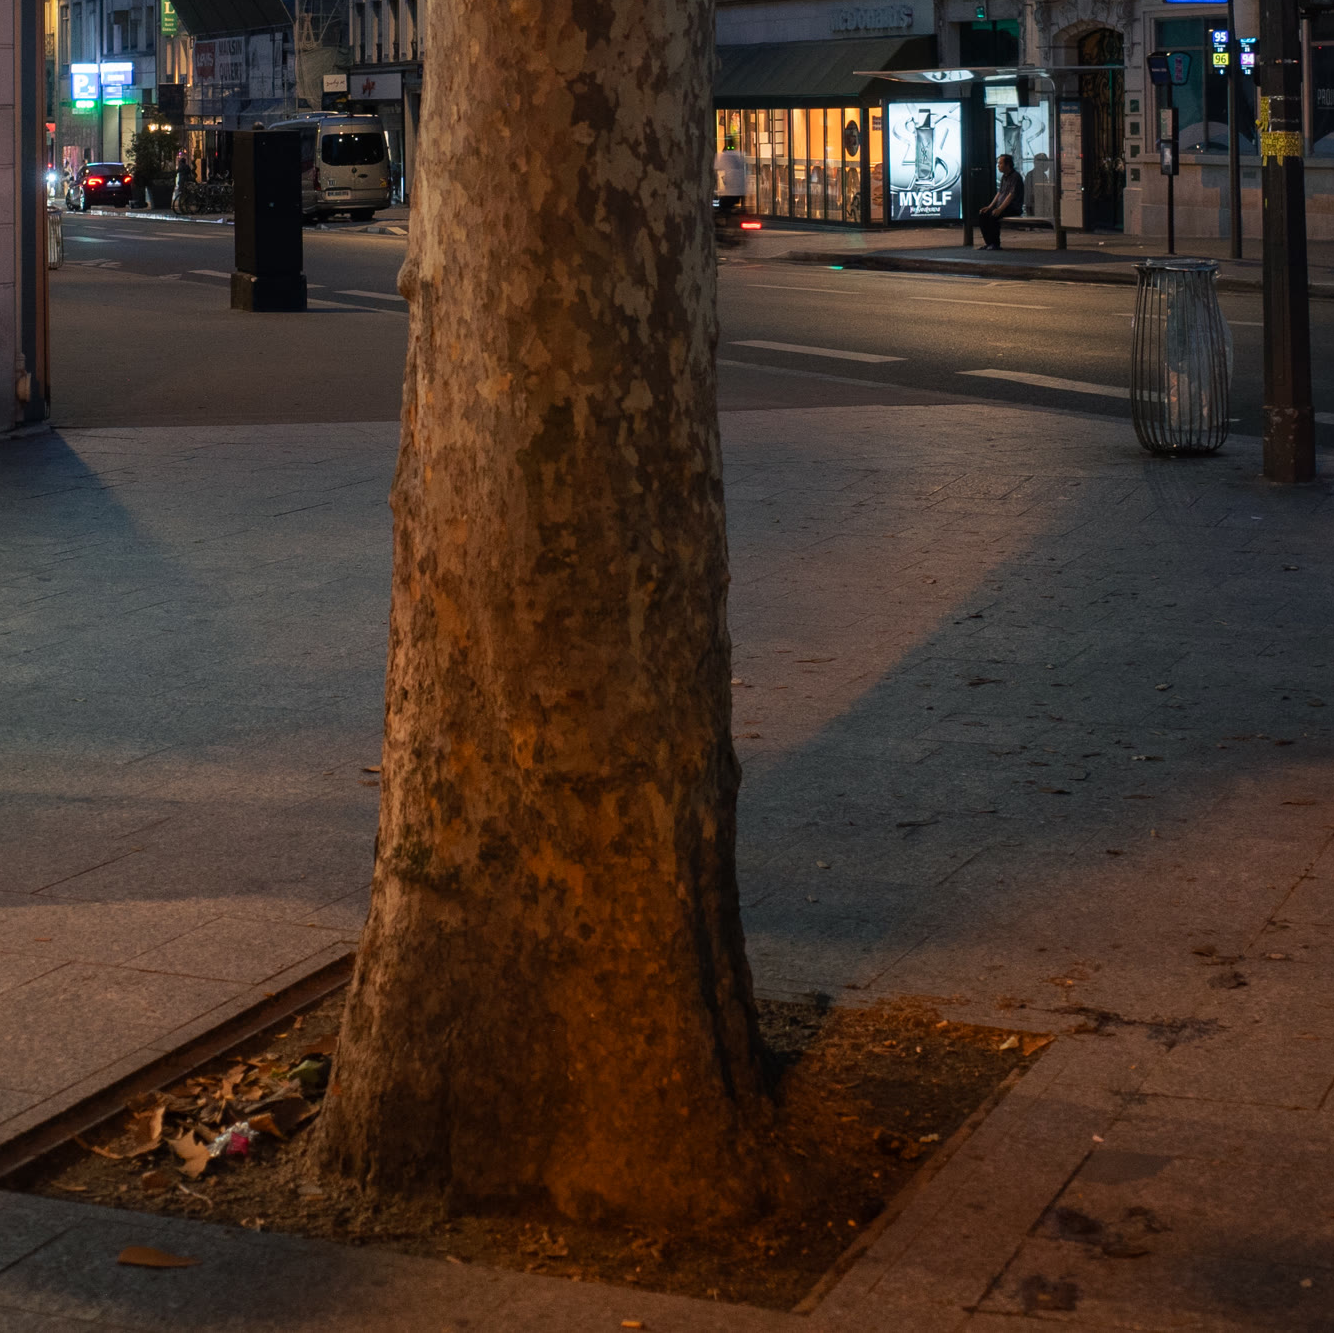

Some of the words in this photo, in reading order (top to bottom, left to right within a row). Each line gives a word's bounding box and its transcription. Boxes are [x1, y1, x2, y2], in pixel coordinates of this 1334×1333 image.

[1214, 32, 1227, 42] 95
[1215, 54, 1227, 64] 96
[1242, 54, 1254, 64] 94
[899, 191, 952, 207] MYSLF
